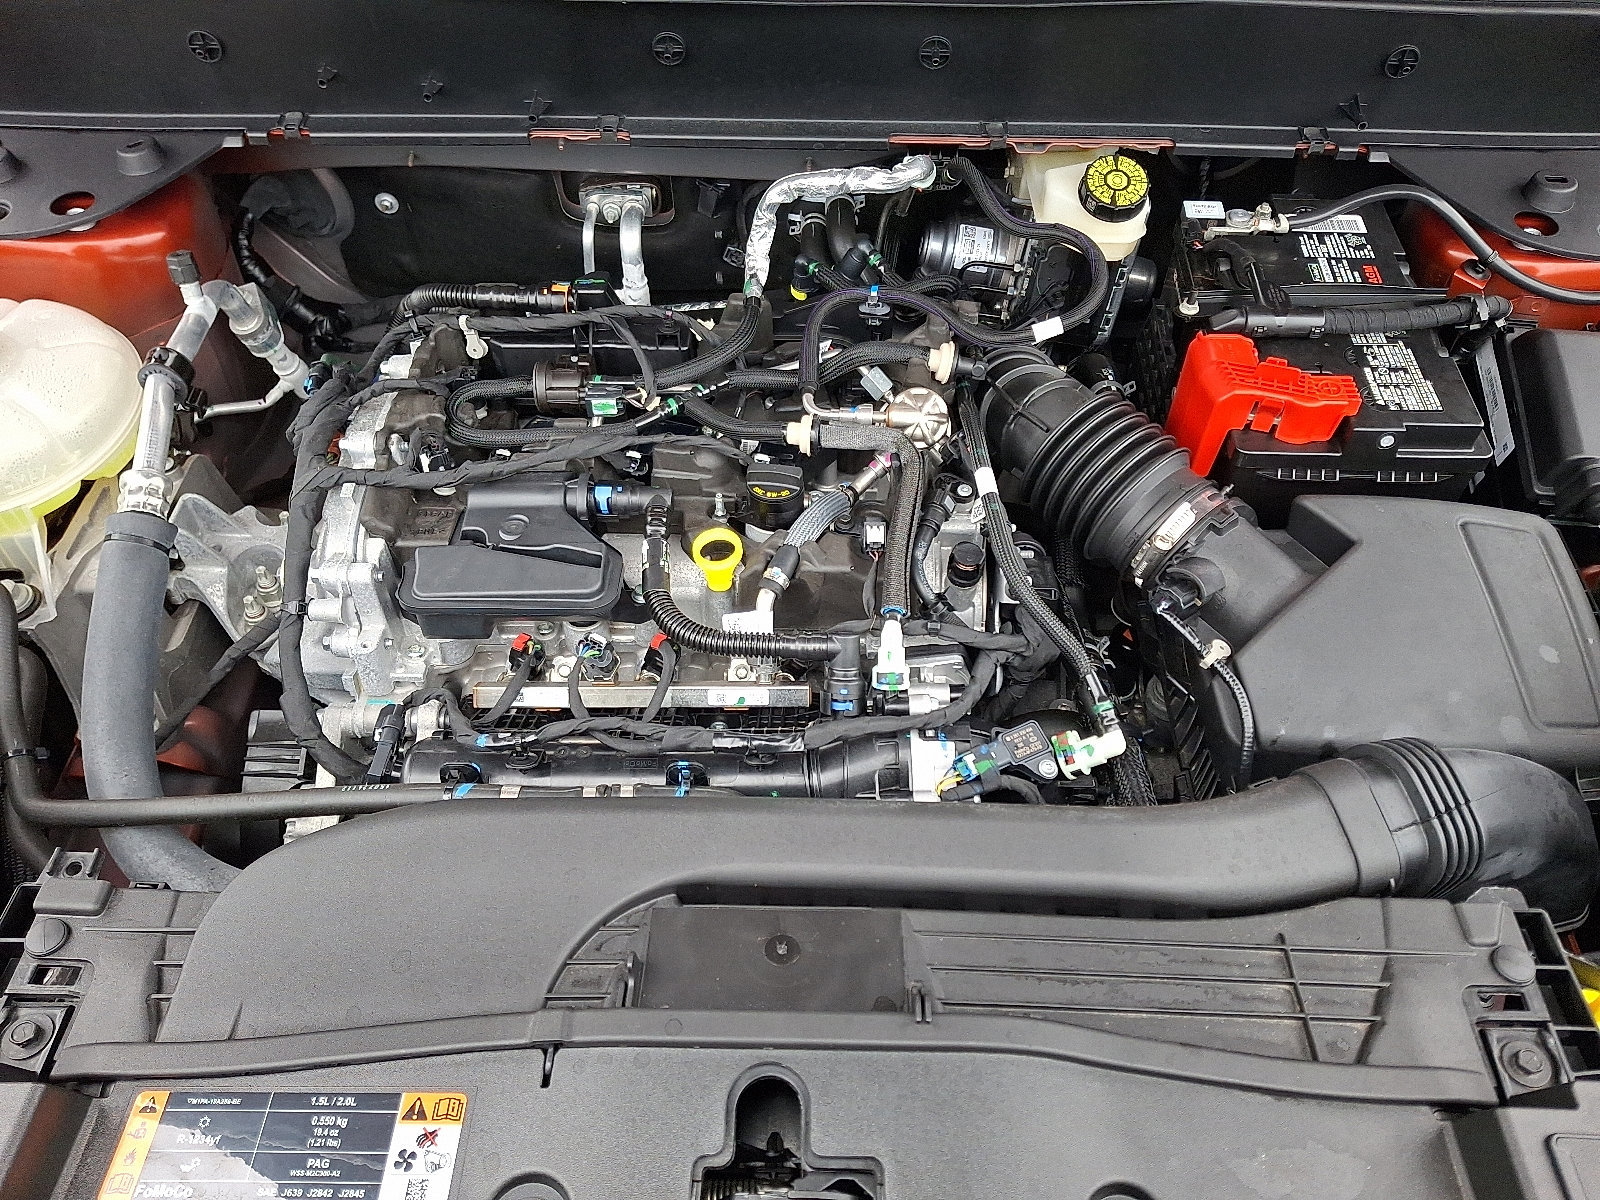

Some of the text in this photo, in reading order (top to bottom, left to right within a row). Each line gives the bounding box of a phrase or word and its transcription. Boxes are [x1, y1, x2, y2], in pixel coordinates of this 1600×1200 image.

[1362, 265, 1379, 284] AGM
[310, 1096, 329, 1106] 1.5L
[337, 1096, 357, 1107] 2.0L
[311, 1115, 349, 1129] 0.550 kg
[313, 1127, 340, 1137] 19.4 oz
[176, 1133, 223, 1147] R-1234yf
[307, 1138, 342, 1149] (1.21 lbs)
[306, 1158, 330, 1169] PAG
[133, 1182, 194, 1199] FoMoCo
[256, 1186, 366, 1198] SAE J639 J2842 J2845
